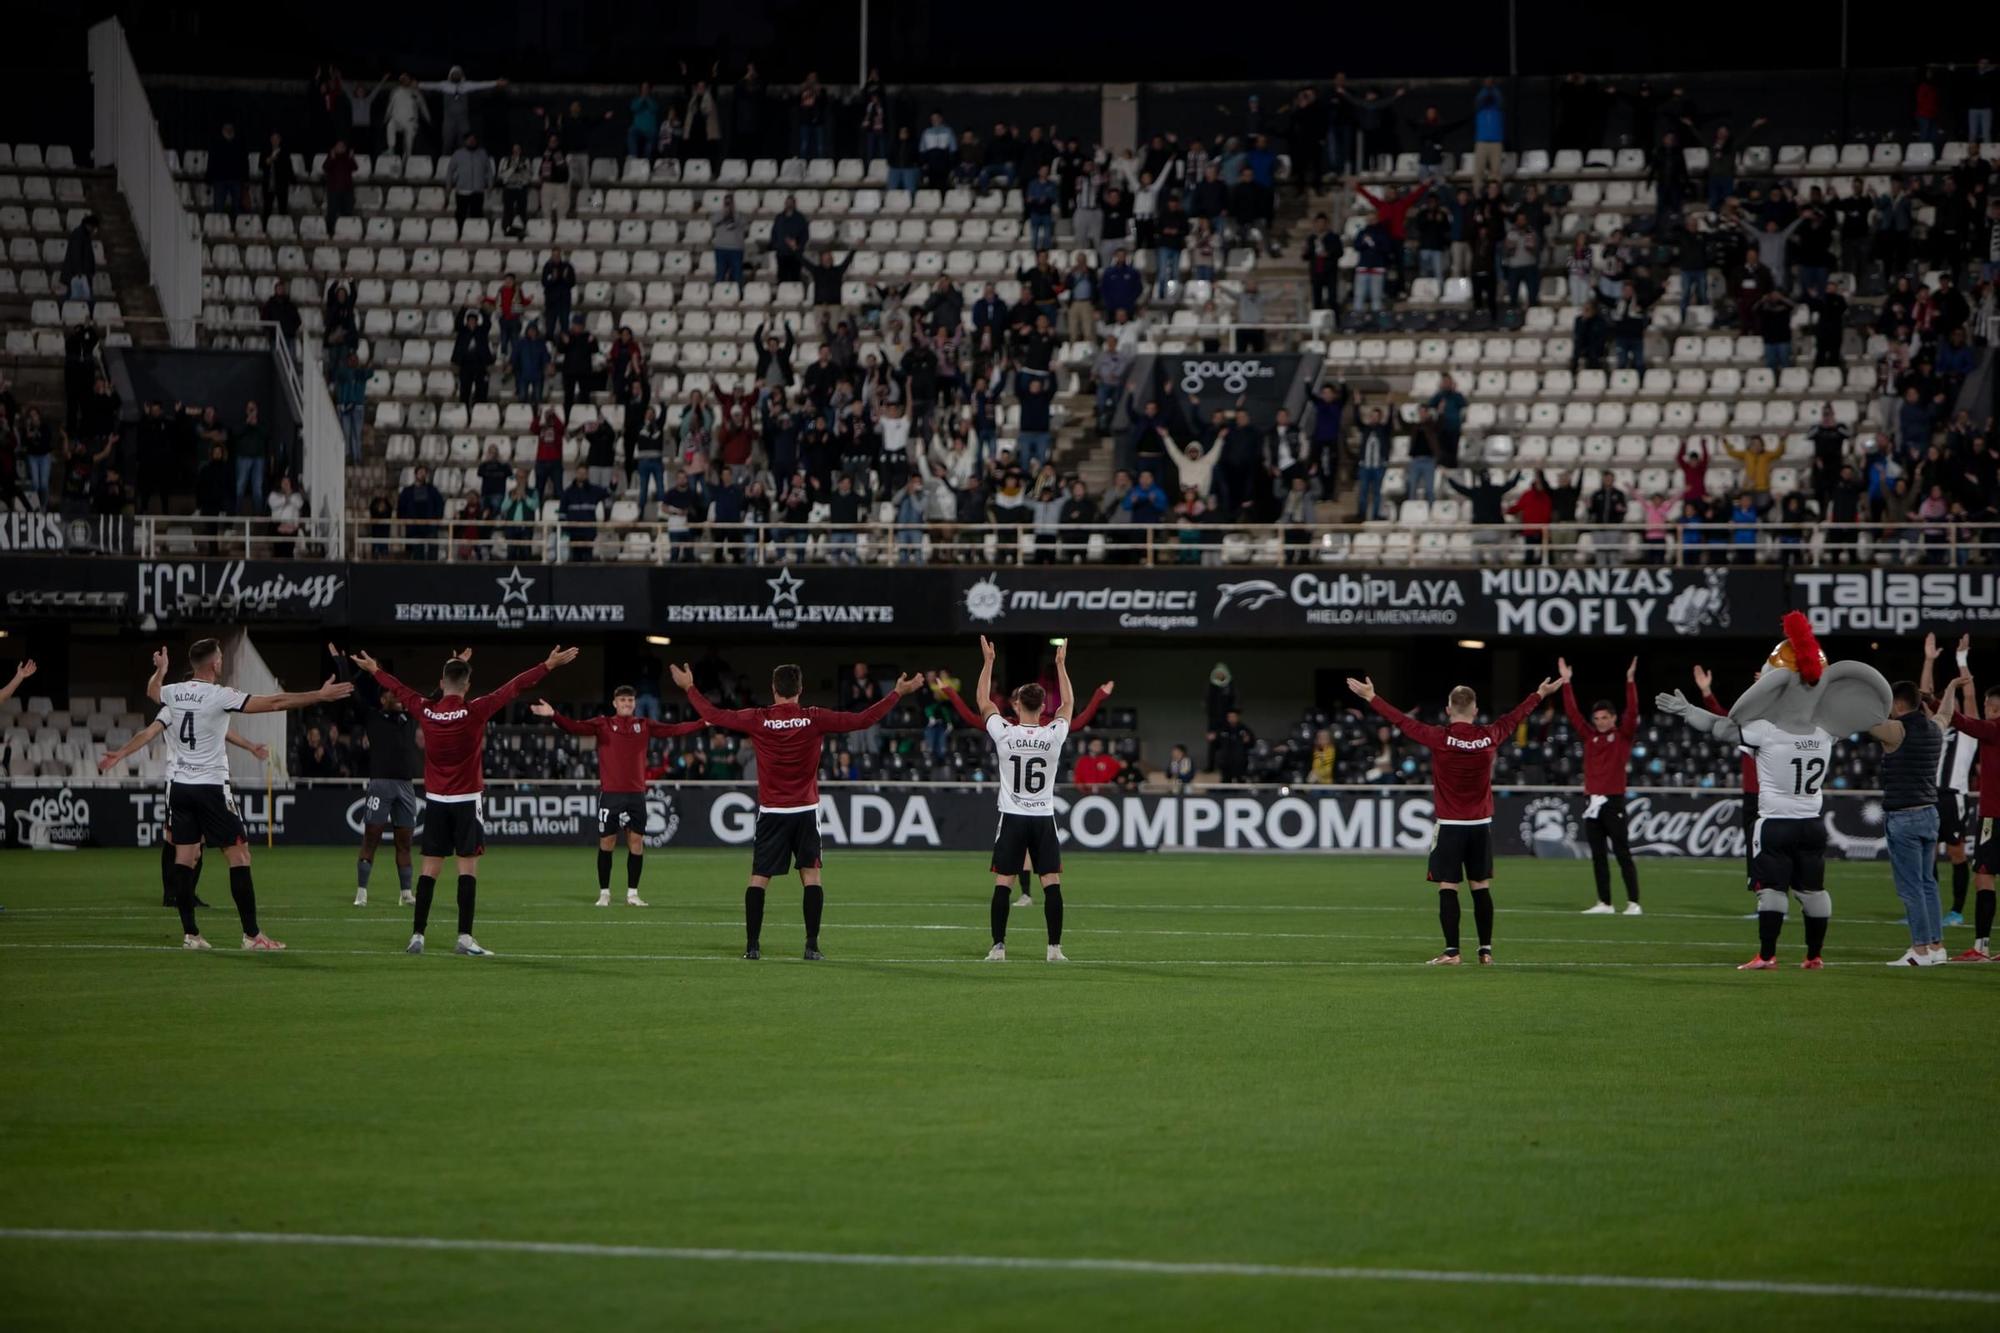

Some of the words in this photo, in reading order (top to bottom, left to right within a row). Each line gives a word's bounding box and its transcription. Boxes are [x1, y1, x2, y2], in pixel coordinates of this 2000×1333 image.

[1290, 572, 1466, 608] CubiPLAYA
[1480, 568, 1674, 596] MUDANZAS
[1794, 567, 2000, 606] Talasu
[1009, 587, 1198, 610] mundobici
[395, 603, 508, 622] ESTRELLA
[526, 604, 625, 622] LEVANTE
[667, 605, 777, 622] ESTRELLA
[794, 606, 894, 622] LEVANTE
[1119, 612, 1199, 631] Cartagena
[1306, 609, 1353, 624] HIELO
[1495, 597, 1657, 636] MOFLY
[1808, 606, 1920, 636] group
[424, 707, 468, 720] macron
[763, 717, 811, 730] macron
[180, 711, 196, 750] 4
[1446, 735, 1492, 749] macron
[1016, 739, 1051, 751] CALERO
[1794, 740, 1820, 750] SURU
[1009, 755, 1047, 794] 16
[1790, 758, 1825, 795] 12
[533, 818, 580, 834] Movil
[709, 791, 941, 845] GADA
[1053, 795, 1435, 849] OMPROMIS
